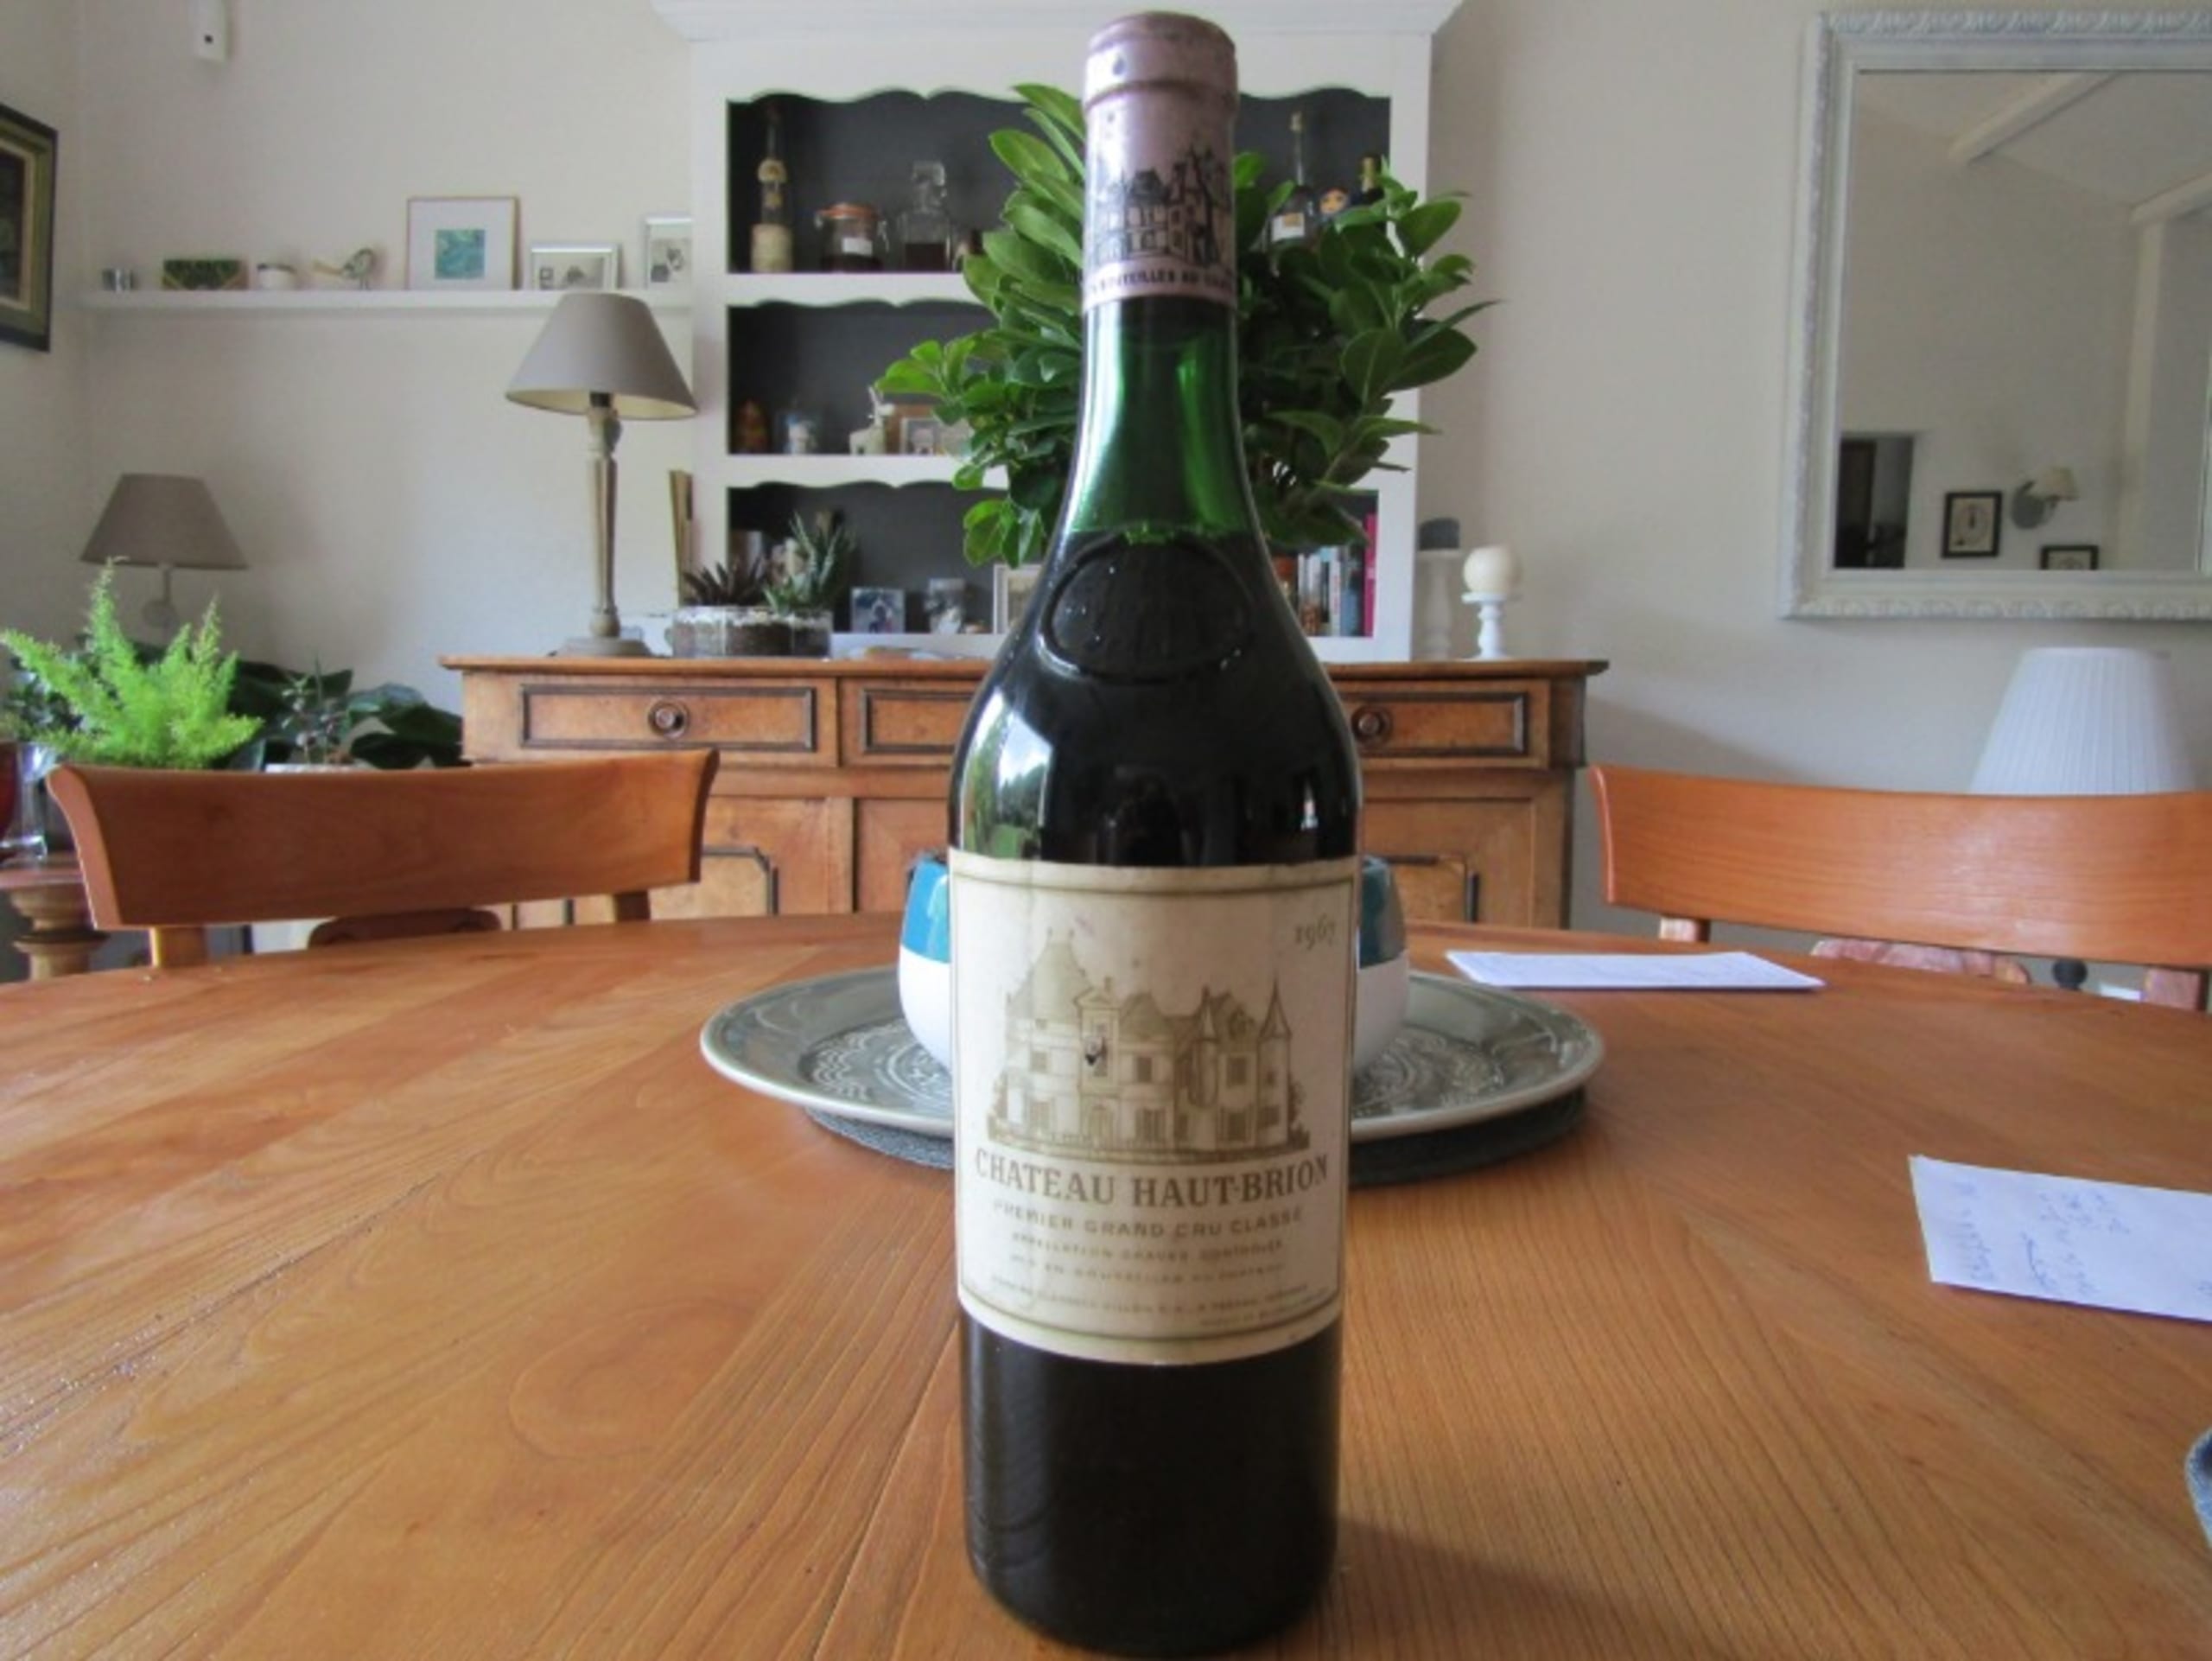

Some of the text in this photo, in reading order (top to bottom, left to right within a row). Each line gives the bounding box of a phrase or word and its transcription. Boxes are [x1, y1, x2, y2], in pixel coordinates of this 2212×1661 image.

[976, 1148, 1328, 1207] CHATEAU HAUT-BRION
[994, 1199, 1072, 1230] PREMIER
[1084, 1219, 1164, 1238] GRAND
[1176, 1222, 1223, 1238] CRU
